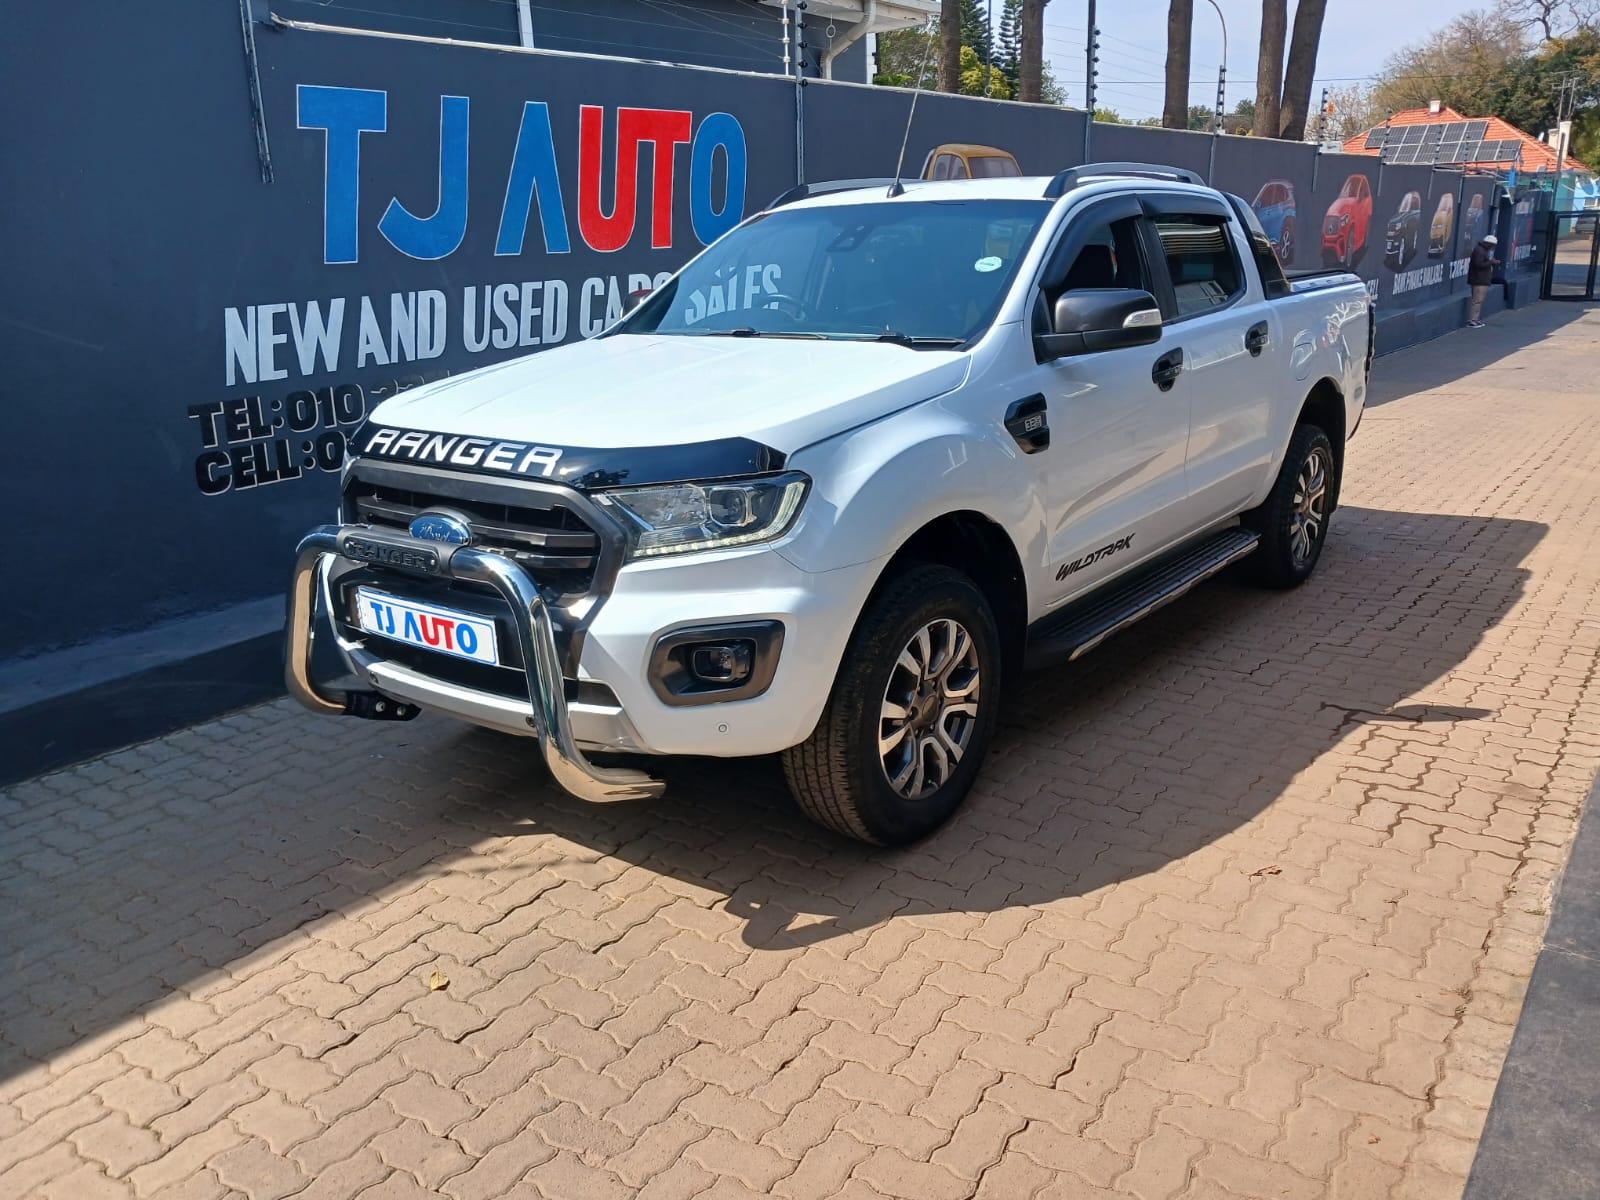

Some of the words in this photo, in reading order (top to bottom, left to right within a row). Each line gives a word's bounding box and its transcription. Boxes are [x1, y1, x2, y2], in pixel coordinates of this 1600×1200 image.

[296, 84, 470, 264] TJ
[494, 101, 747, 256] AUTO
[224, 298, 345, 386] NEW
[357, 290, 446, 369] AND
[463, 280, 566, 352] USED
[579, 272, 674, 340] CA
[364, 427, 563, 477] RANGER
[1055, 533, 1136, 582] WILDTRAK
[370, 601, 396, 635] TJ
[404, 611, 478, 655] AUTO
